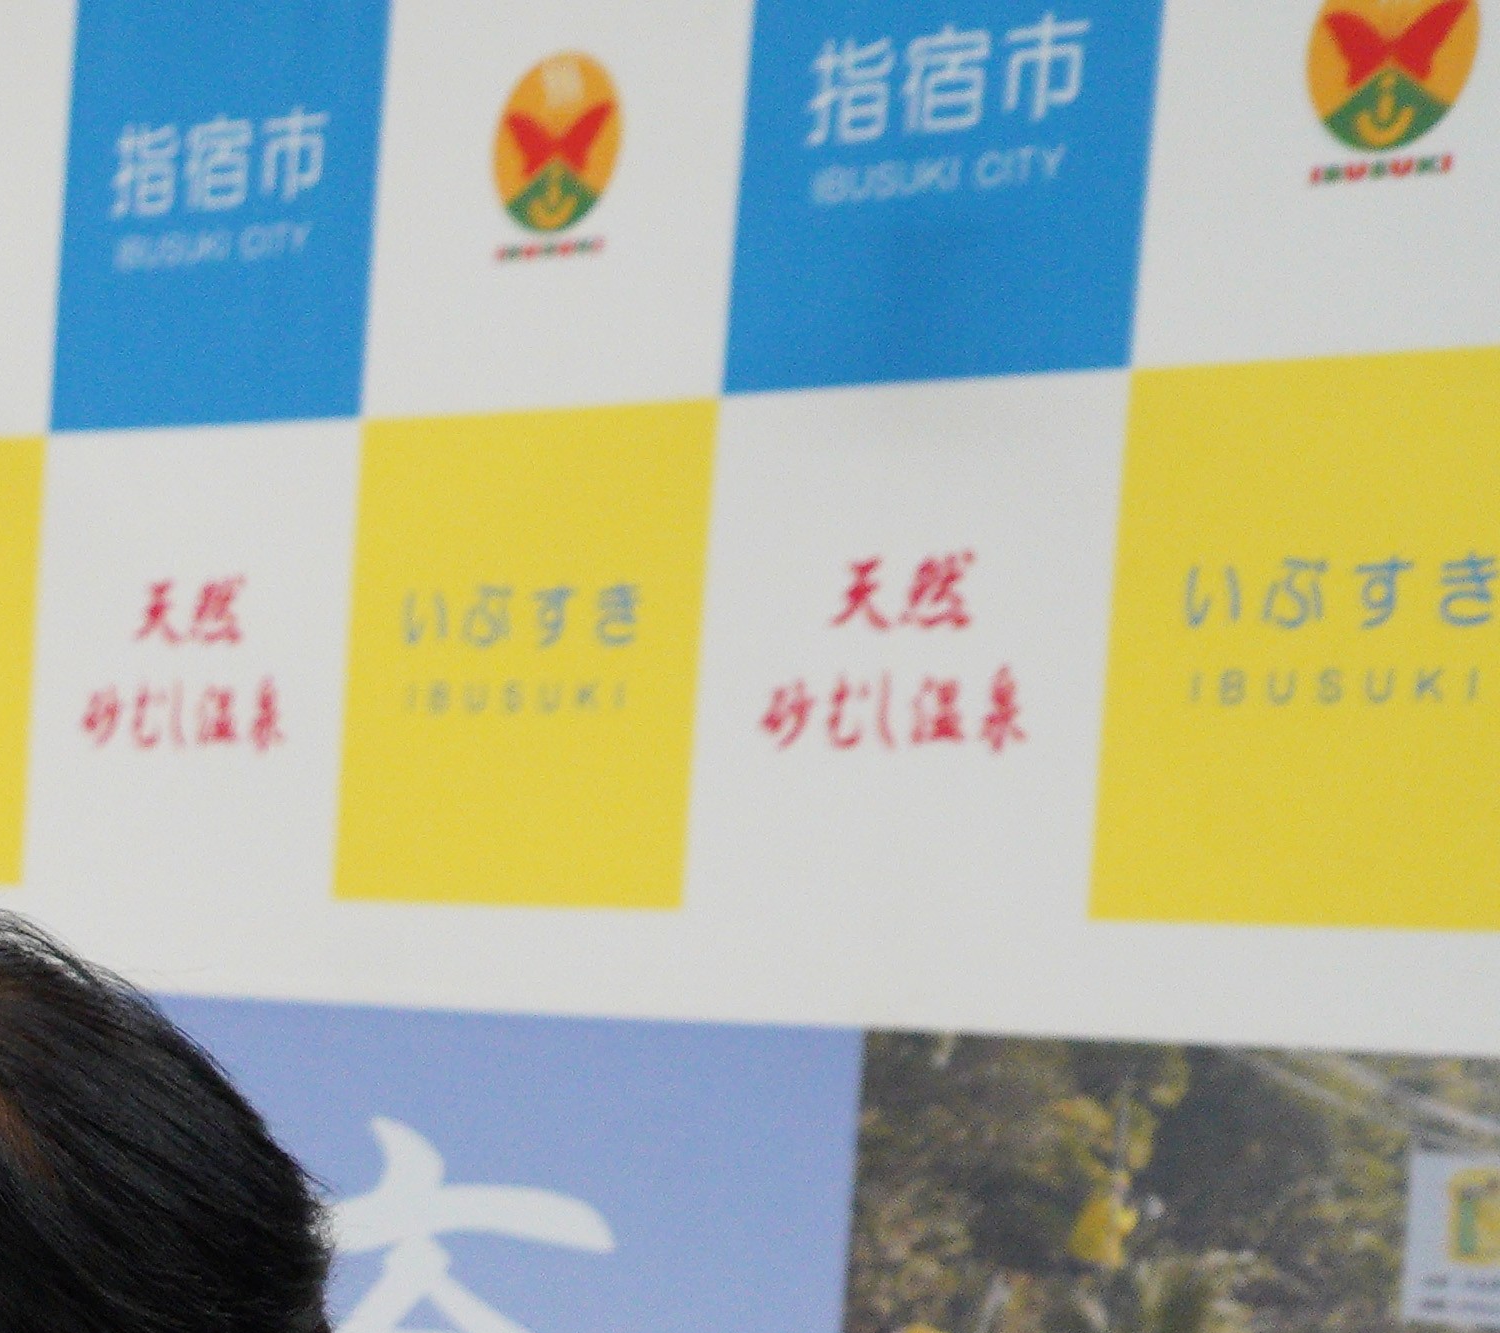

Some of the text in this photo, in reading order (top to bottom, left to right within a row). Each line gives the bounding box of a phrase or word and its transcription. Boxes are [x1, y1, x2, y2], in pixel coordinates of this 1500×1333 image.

[804, 12, 1092, 146] 指宿市
[112, 106, 330, 220] 指宿市
[810, 144, 1068, 204] IBUSUKI CITY
[134, 573, 246, 646] 天然
[400, 581, 641, 650] いぶすき
[828, 547, 976, 632] 天然
[1184, 551, 1499, 629] いぶすき
[1188, 666, 1480, 707] IBUSUKI
